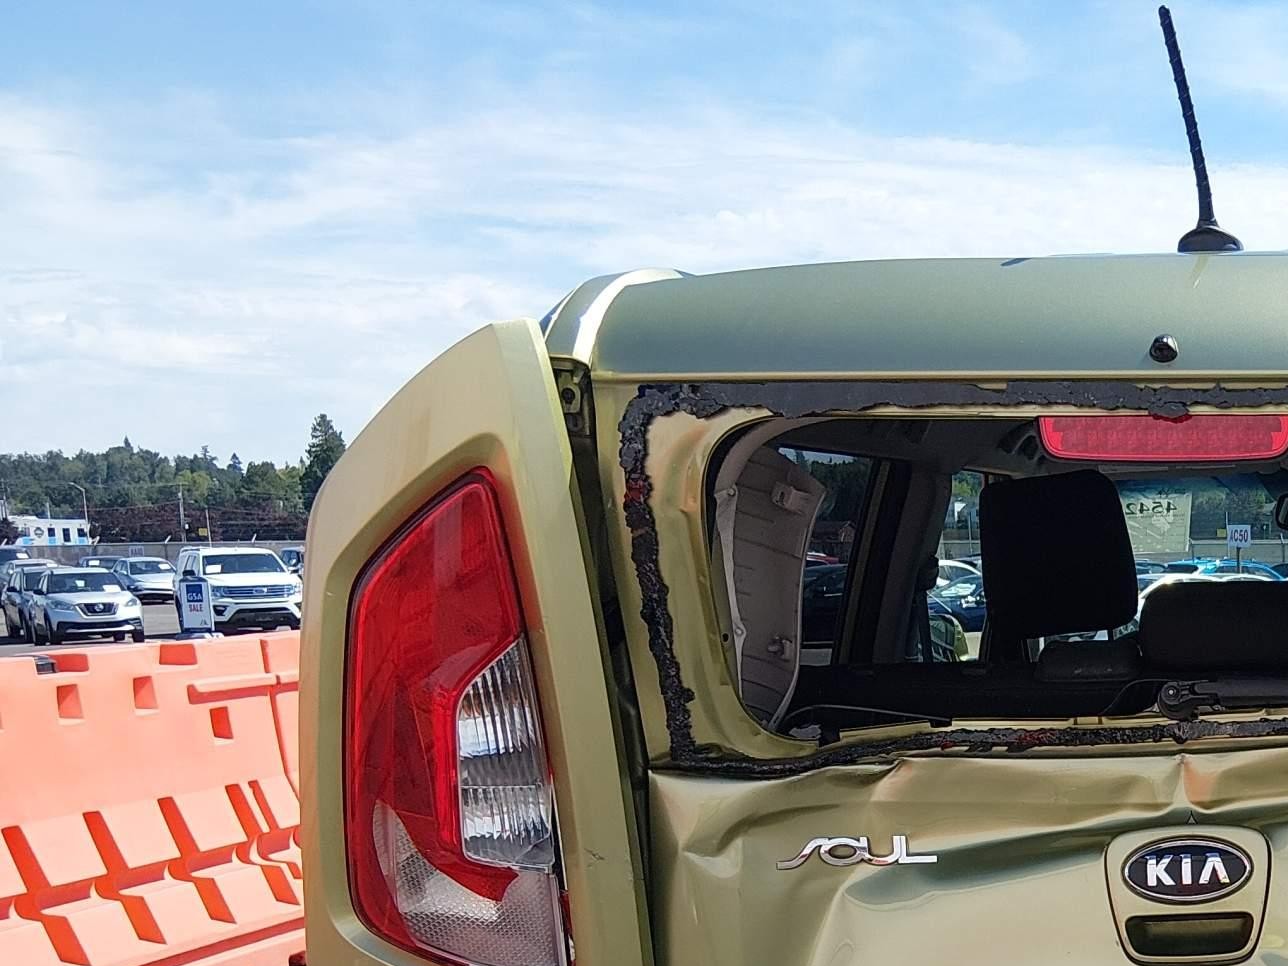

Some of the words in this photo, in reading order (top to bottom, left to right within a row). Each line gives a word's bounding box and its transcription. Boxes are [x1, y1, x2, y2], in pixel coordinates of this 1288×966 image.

[187, 592, 203, 601] GSA
[776, 835, 938, 870] SOUL
[1144, 852, 1230, 887] KIA
